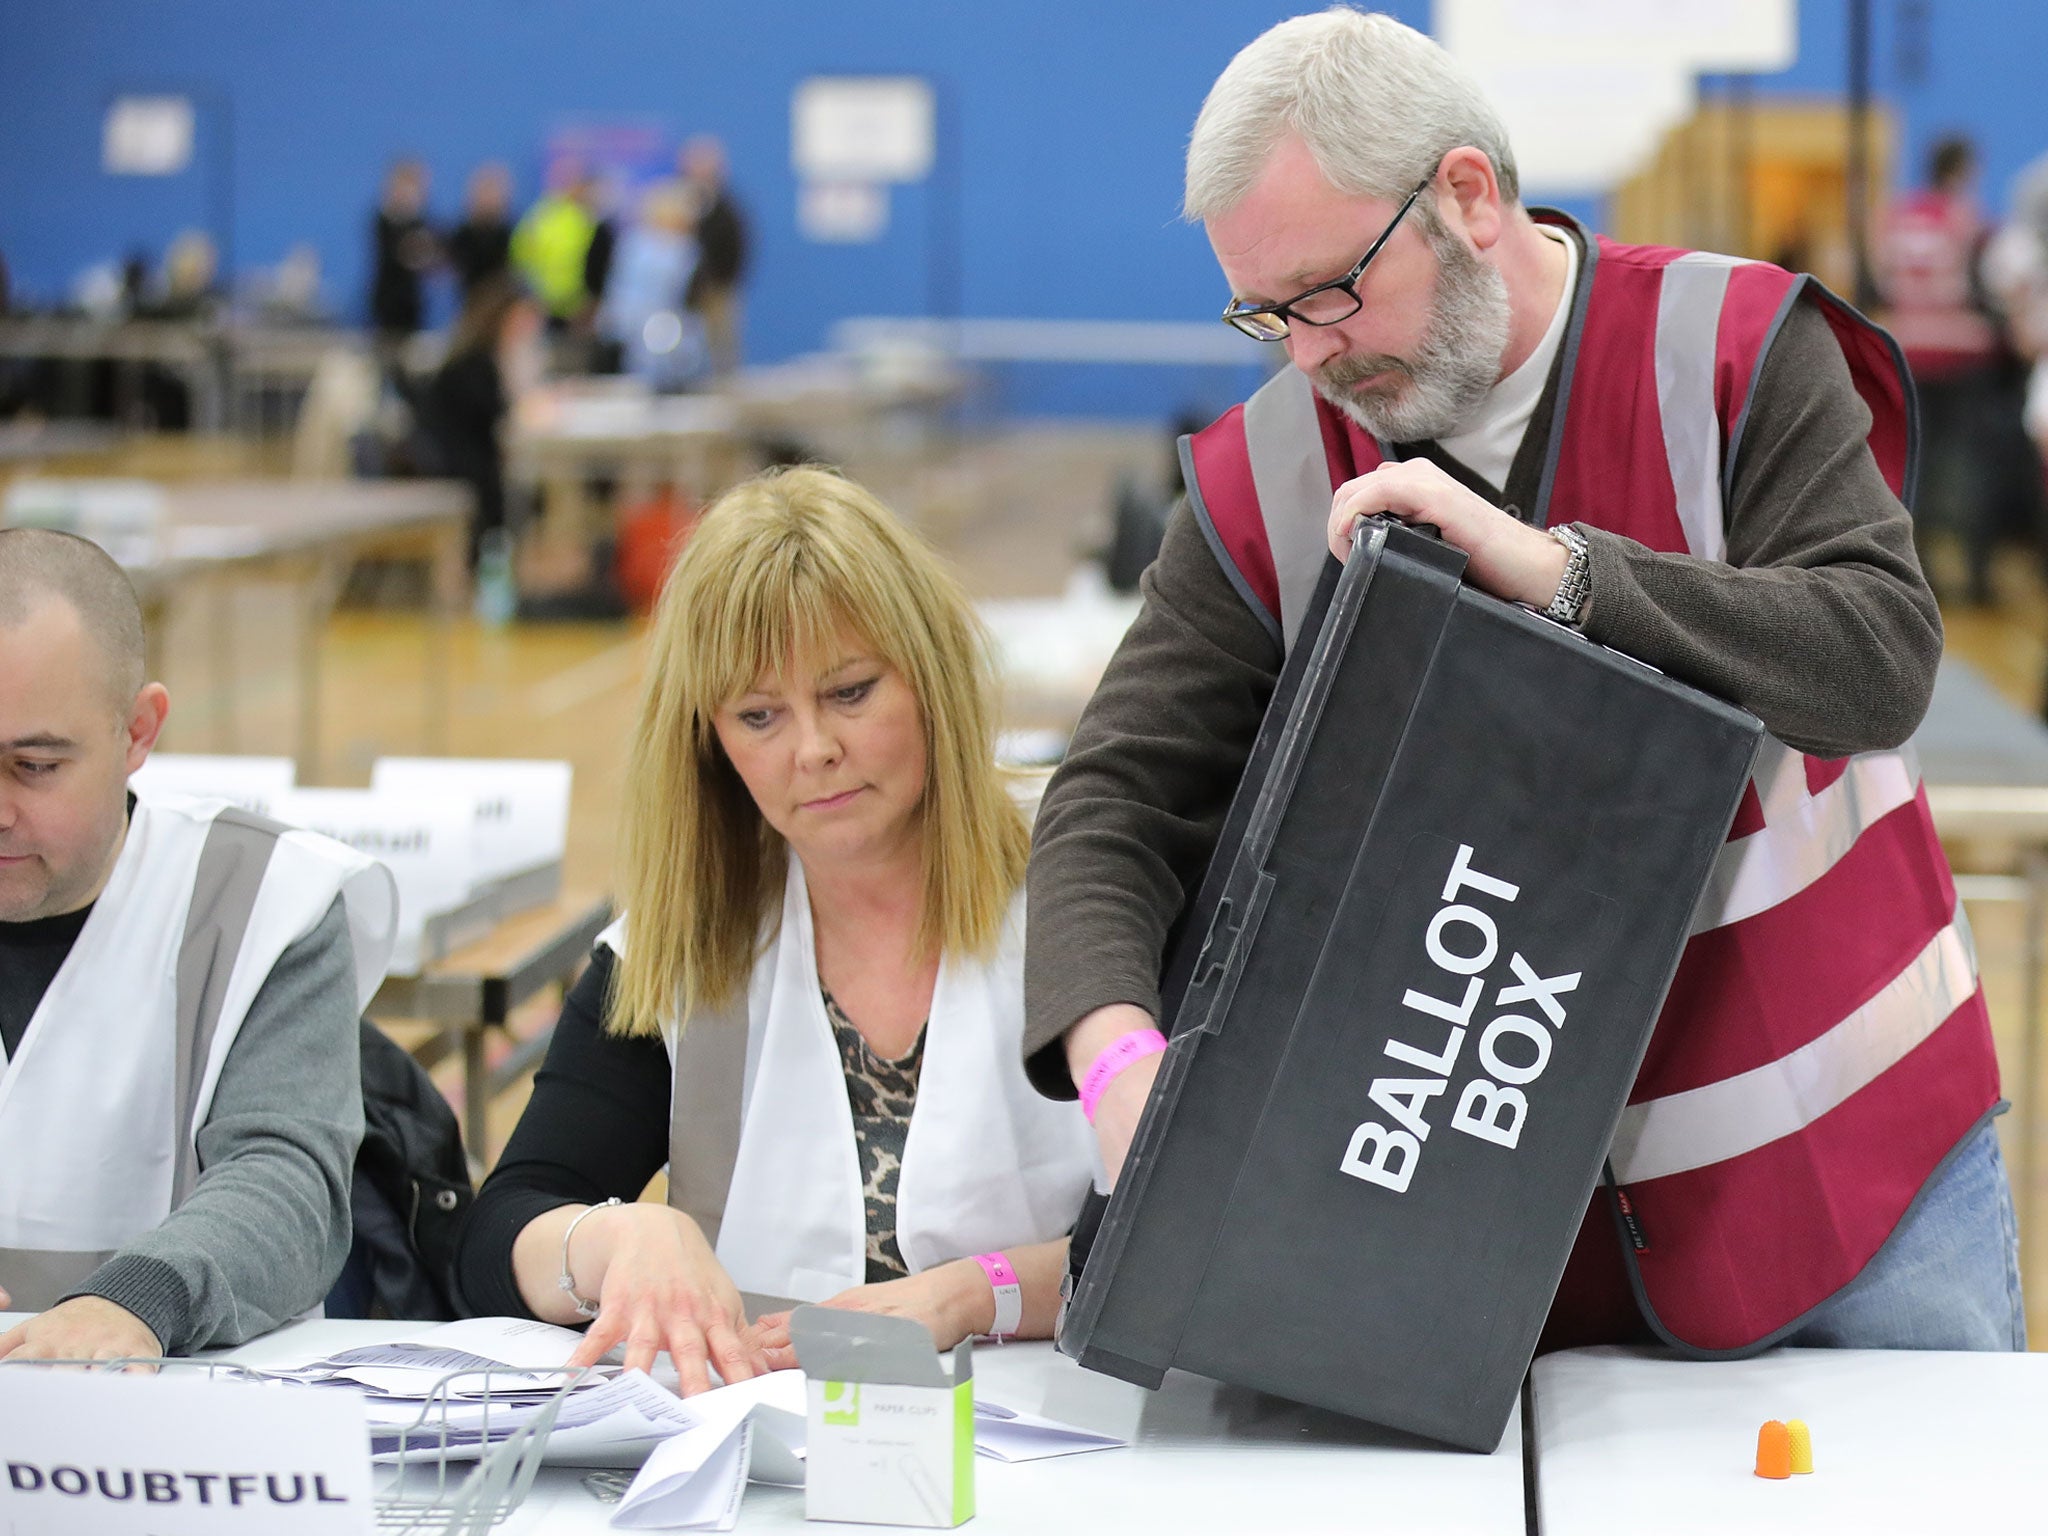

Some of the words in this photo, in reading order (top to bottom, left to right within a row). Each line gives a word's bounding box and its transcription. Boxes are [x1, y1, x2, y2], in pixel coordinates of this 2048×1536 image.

[1340, 844, 1519, 1194] BALLOT
[1451, 951, 1582, 1150] BOX
[873, 1403, 904, 1415] PAPER
[908, 1404, 939, 1417] CLIPS
[6, 1460, 349, 1507] DOUBTFUL
